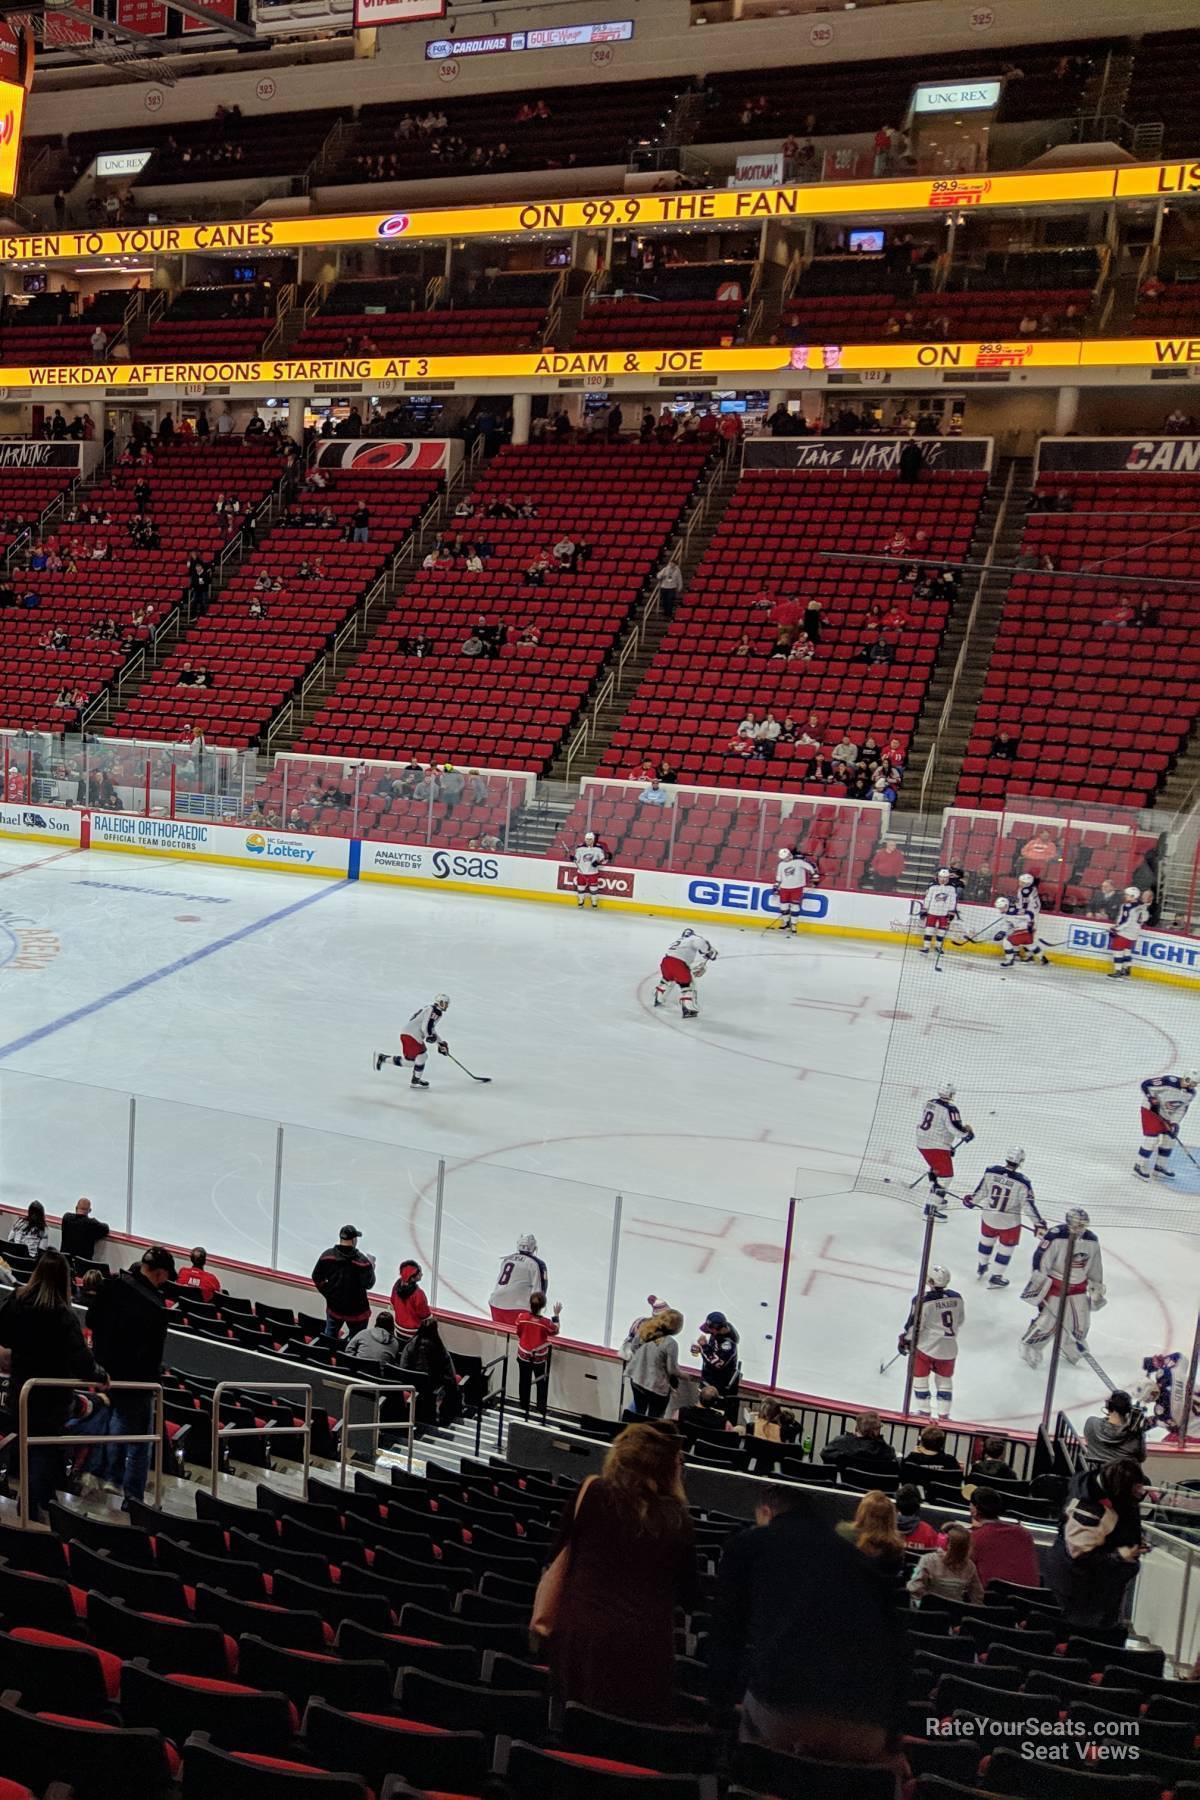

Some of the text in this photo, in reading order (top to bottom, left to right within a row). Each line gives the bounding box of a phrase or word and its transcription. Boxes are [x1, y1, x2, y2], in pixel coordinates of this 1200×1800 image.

[453, 38, 507, 54] CAROLINAS
[440, 66, 456, 77] 324
[258, 84, 274, 95] 323
[927, 89, 988, 105] UNC REX
[104, 158, 144, 171] UNC REX
[932, 180, 958, 192] 99.9
[929, 190, 983, 208] ESPN
[520, 190, 798, 230] ON 99.9 THE FAN
[74, 233, 104, 255] TO
[117, 229, 181, 252] YOUR
[194, 221, 275, 248] CANES
[535, 350, 703, 374] ADAM & JOE
[917, 344, 1002, 366] ON 99.9
[976, 353, 1025, 369] ESPN
[30, 359, 429, 385] WEEKDAY AFTERNOONS STARTING AT 3
[586, 375, 602, 385] 120
[864, 370, 881, 380] 121
[189, 383, 201, 393] 118
[377, 380, 391, 390] 119
[796, 443, 842, 467] TAKE
[48, 819, 70, 832] Son
[94, 815, 208, 843] RALEIGH ORTHOPAEDIC
[103, 833, 197, 850] OFFICIAL TEAM DOCTORS
[266, 844, 315, 863] Lottery
[375, 850, 422, 862] ANALYTICS
[374, 858, 422, 869] POWERED BY
[1131, 939, 1199, 966] LIGHT
[989, 1183, 1012, 1211] 91
[940, 1311, 955, 1337] 9
